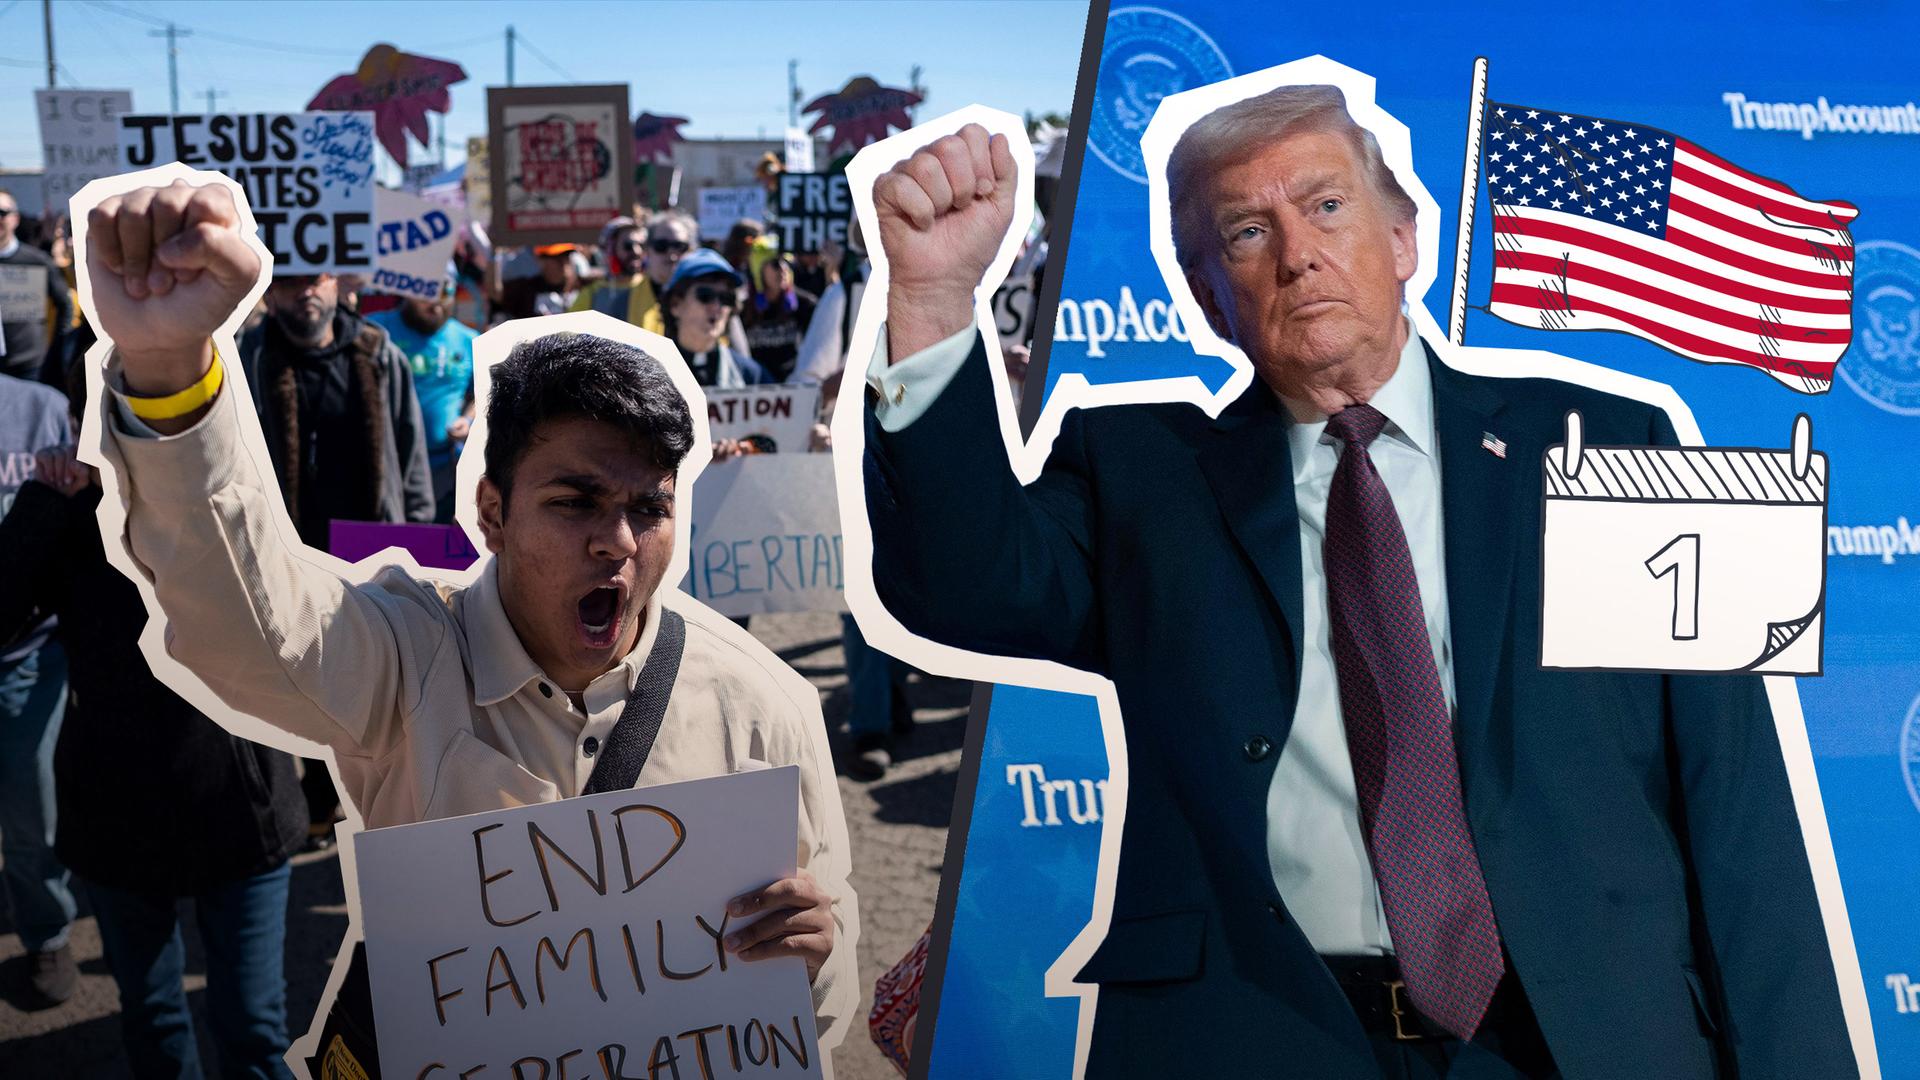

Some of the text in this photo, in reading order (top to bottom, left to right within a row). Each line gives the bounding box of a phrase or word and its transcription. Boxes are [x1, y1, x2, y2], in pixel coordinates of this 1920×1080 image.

[122, 114, 297, 167] JESUS
[1722, 92, 1920, 140] TrumpAccount
[203, 167, 320, 208] ATES
[1006, 764, 1108, 827] Tru
[472, 804, 687, 928] END
[427, 909, 731, 1026] FAMILY
